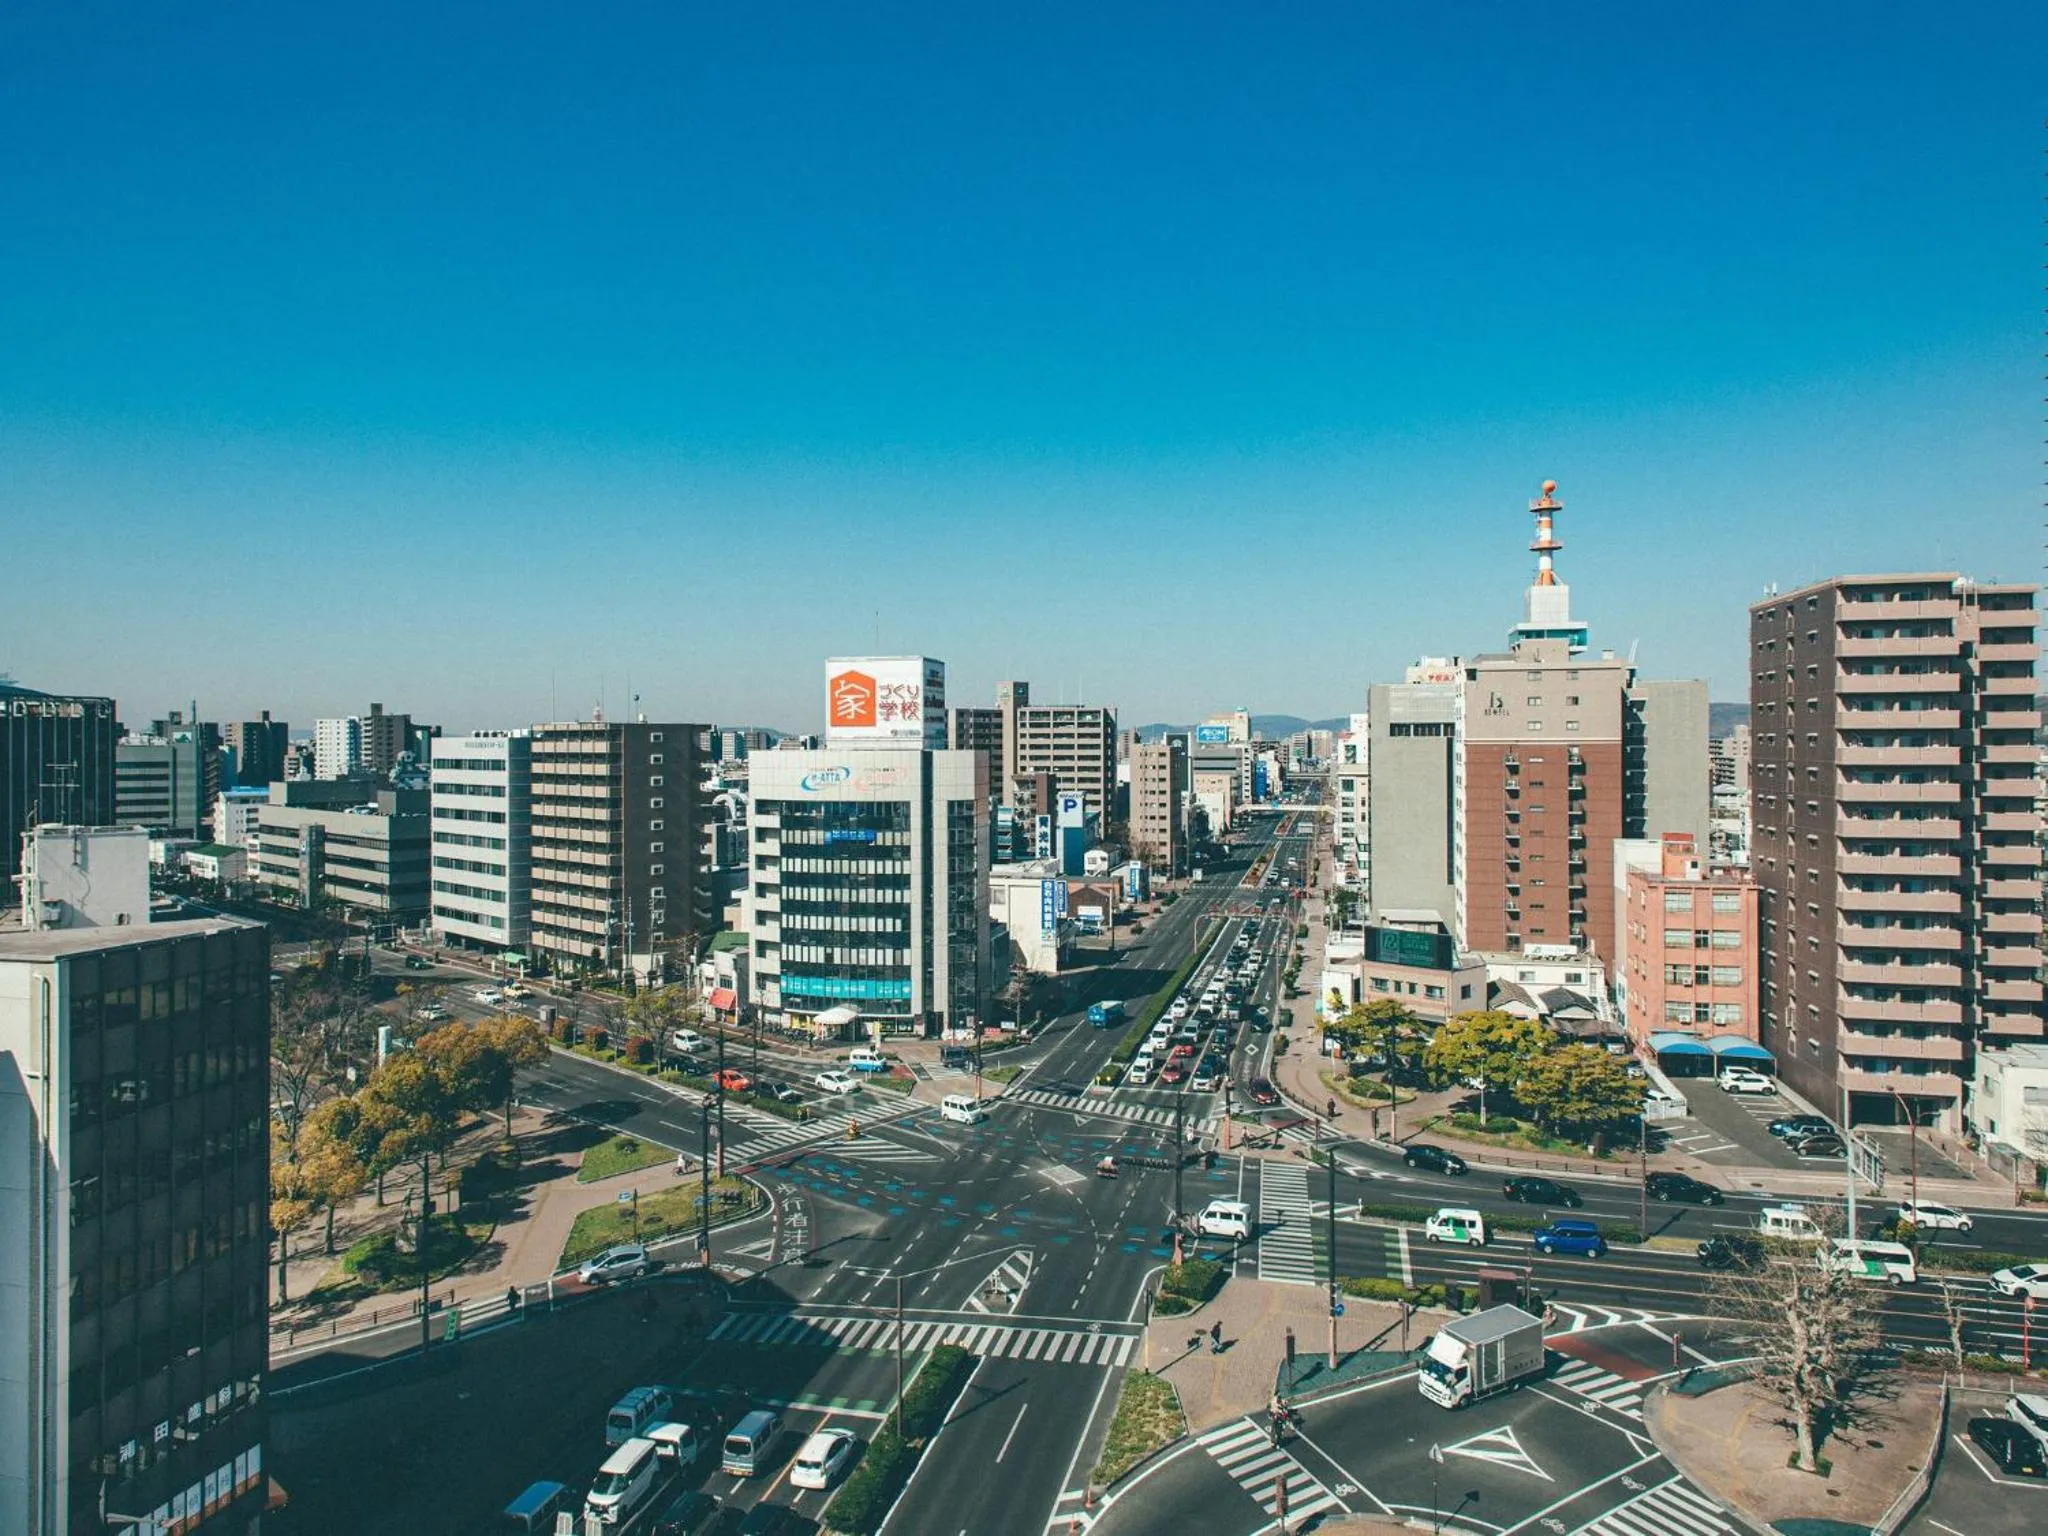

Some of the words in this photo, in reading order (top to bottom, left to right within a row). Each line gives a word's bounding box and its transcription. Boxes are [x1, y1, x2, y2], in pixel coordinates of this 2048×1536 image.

[834, 680, 871, 720] 家
[879, 683, 919, 700] づくり
[879, 700, 920, 721] 学校
[1064, 798, 1078, 813] P
